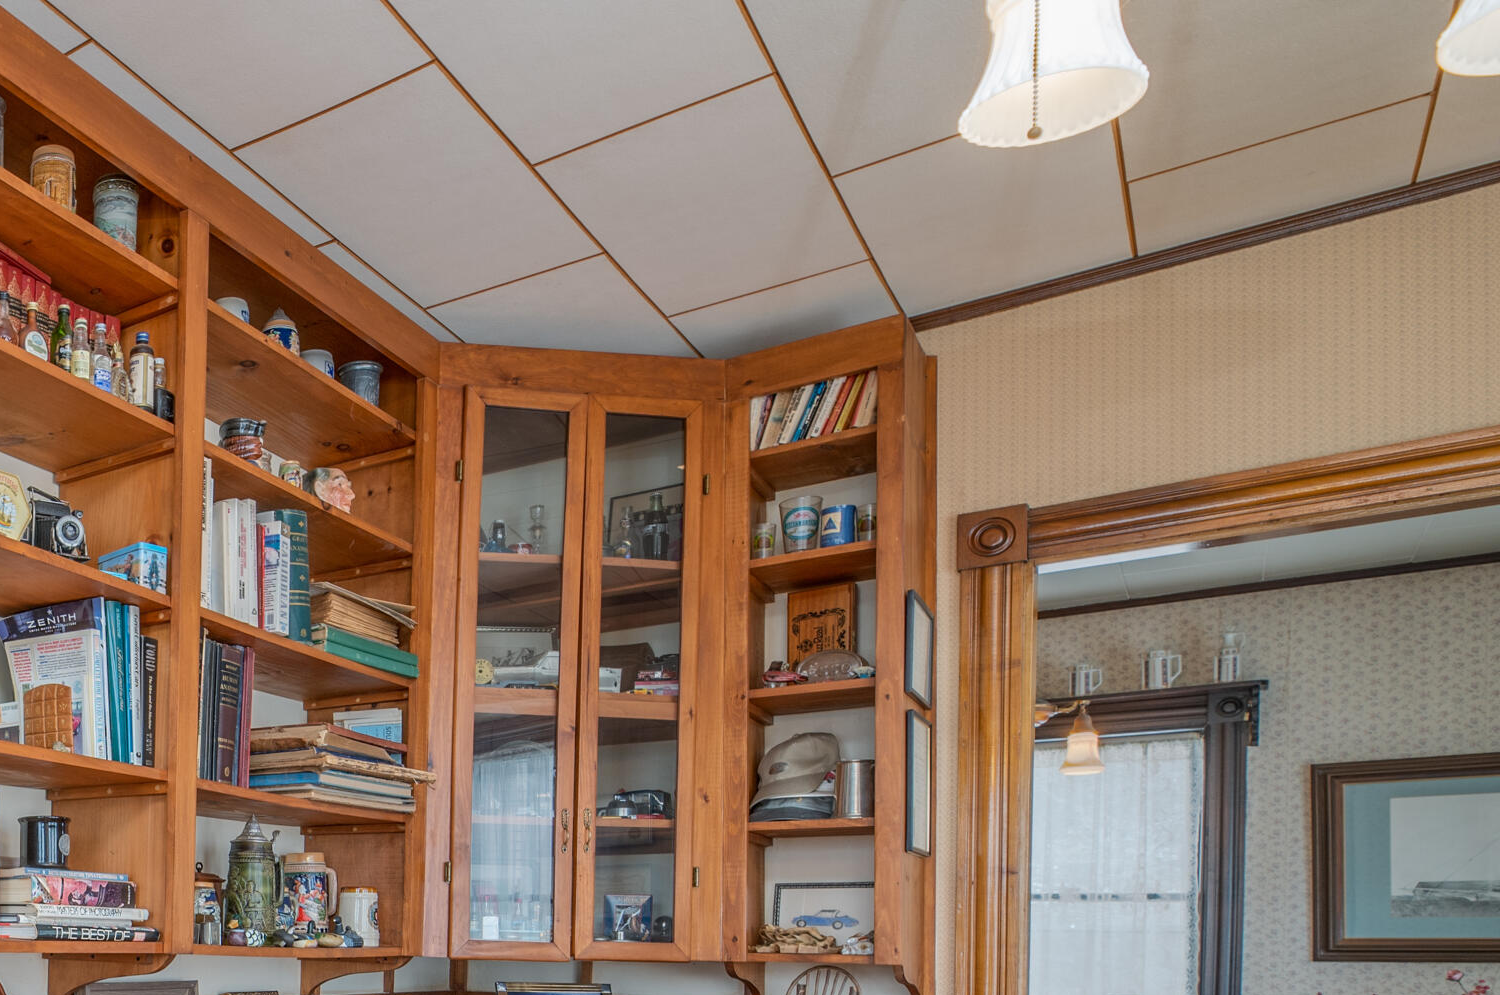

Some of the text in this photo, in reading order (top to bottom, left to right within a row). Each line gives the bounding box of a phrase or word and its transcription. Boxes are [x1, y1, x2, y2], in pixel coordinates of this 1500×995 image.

[26, 612, 77, 629] ZENITH
[145, 643, 156, 671] FORD
[52, 926, 131, 941] THE BEST OF
